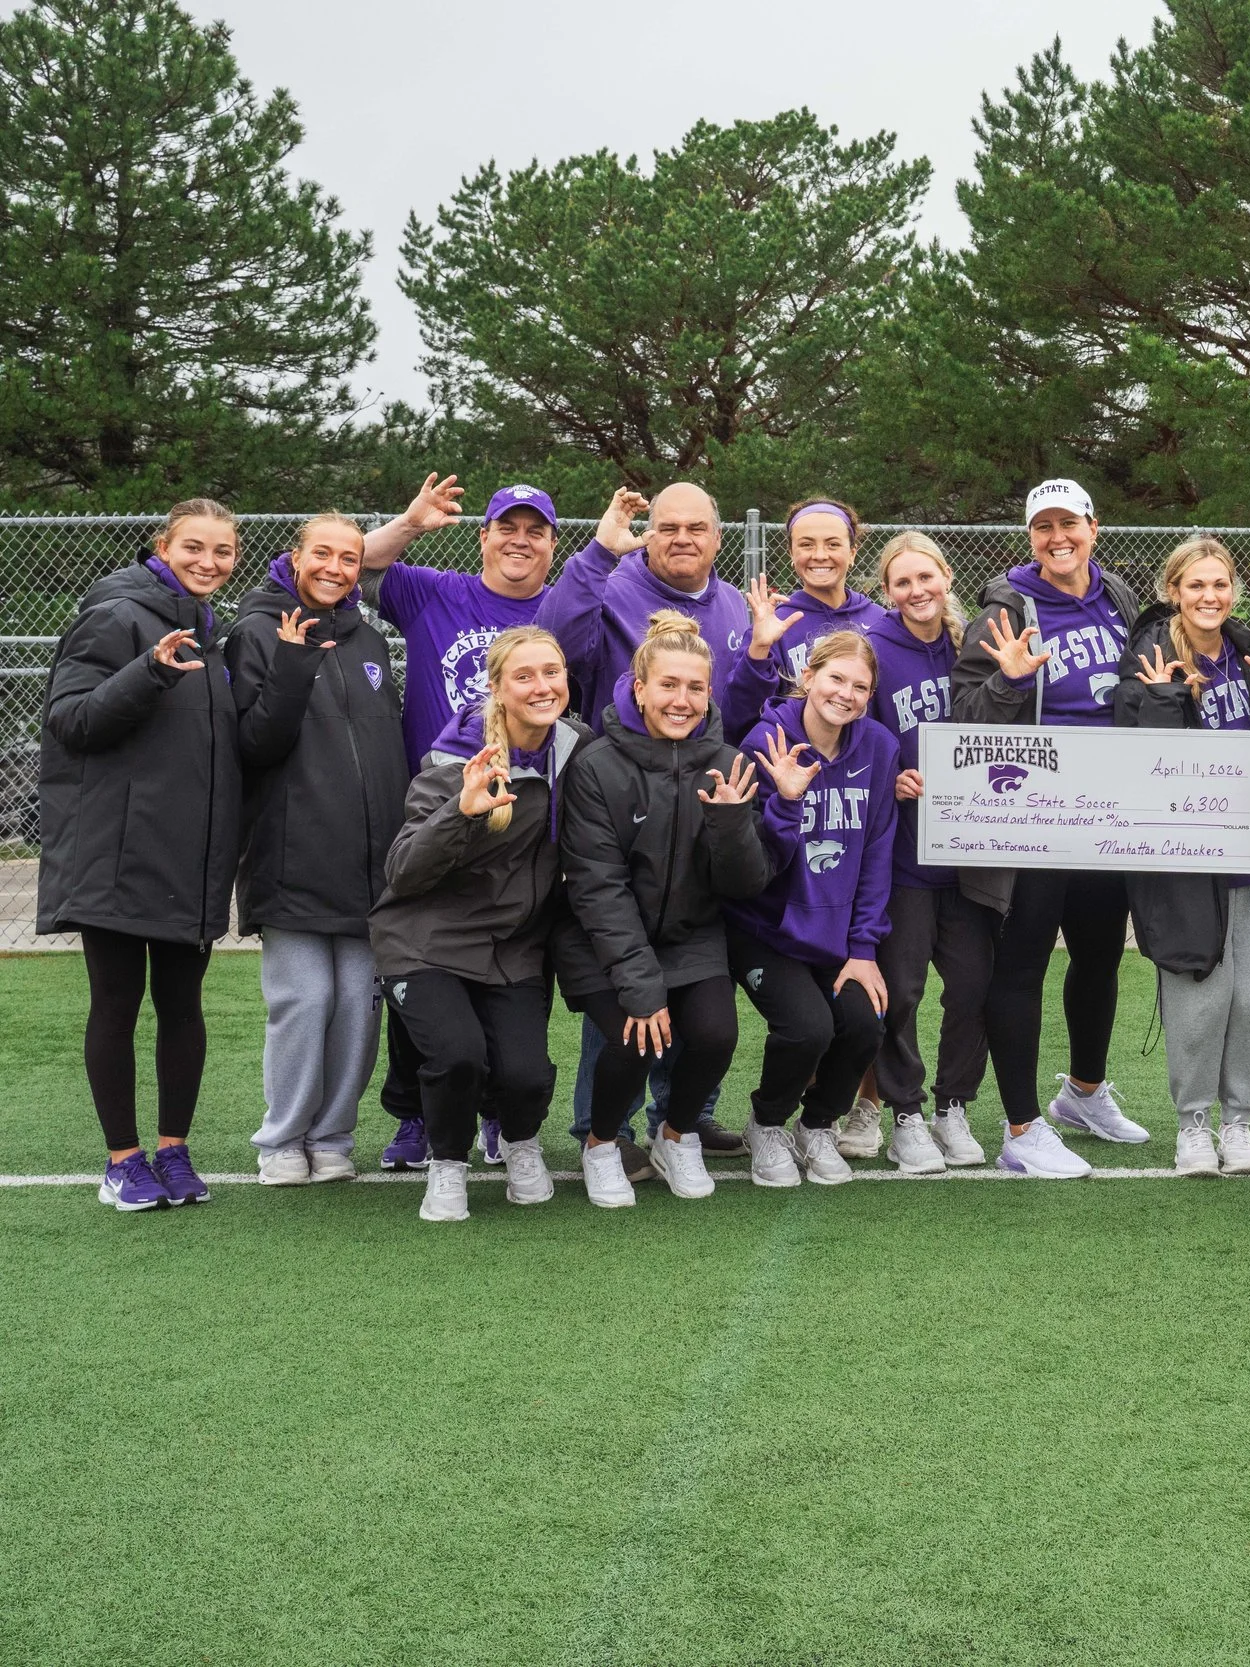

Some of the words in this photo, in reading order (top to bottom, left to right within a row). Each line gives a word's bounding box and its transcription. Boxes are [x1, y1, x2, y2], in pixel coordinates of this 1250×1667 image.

[1032, 485, 1069, 500] K-STATE
[1042, 624, 1128, 683] K-STA
[892, 676, 951, 733] K-ST
[959, 735, 1053, 748] MANHATTAN
[953, 746, 1060, 774] CATBACKERS
[1150, 757, 1184, 779] April
[1192, 762, 1205, 778] 11,
[1209, 764, 1243, 776] 2026
[970, 791, 1016, 807] Kansas
[1075, 795, 1120, 809] Soccer
[1170, 802, 1177, 812] $
[1182, 795, 1229, 813] 6,300
[940, 808, 962, 823] Six
[964, 809, 1010, 824] thousand
[1010, 812, 1029, 825] and
[1030, 812, 1054, 825] three
[1056, 813, 1096, 826] hundred
[949, 836, 986, 852] Superb
[1094, 840, 1156, 856] Manhattan
[1161, 839, 1225, 857] Catbackers
